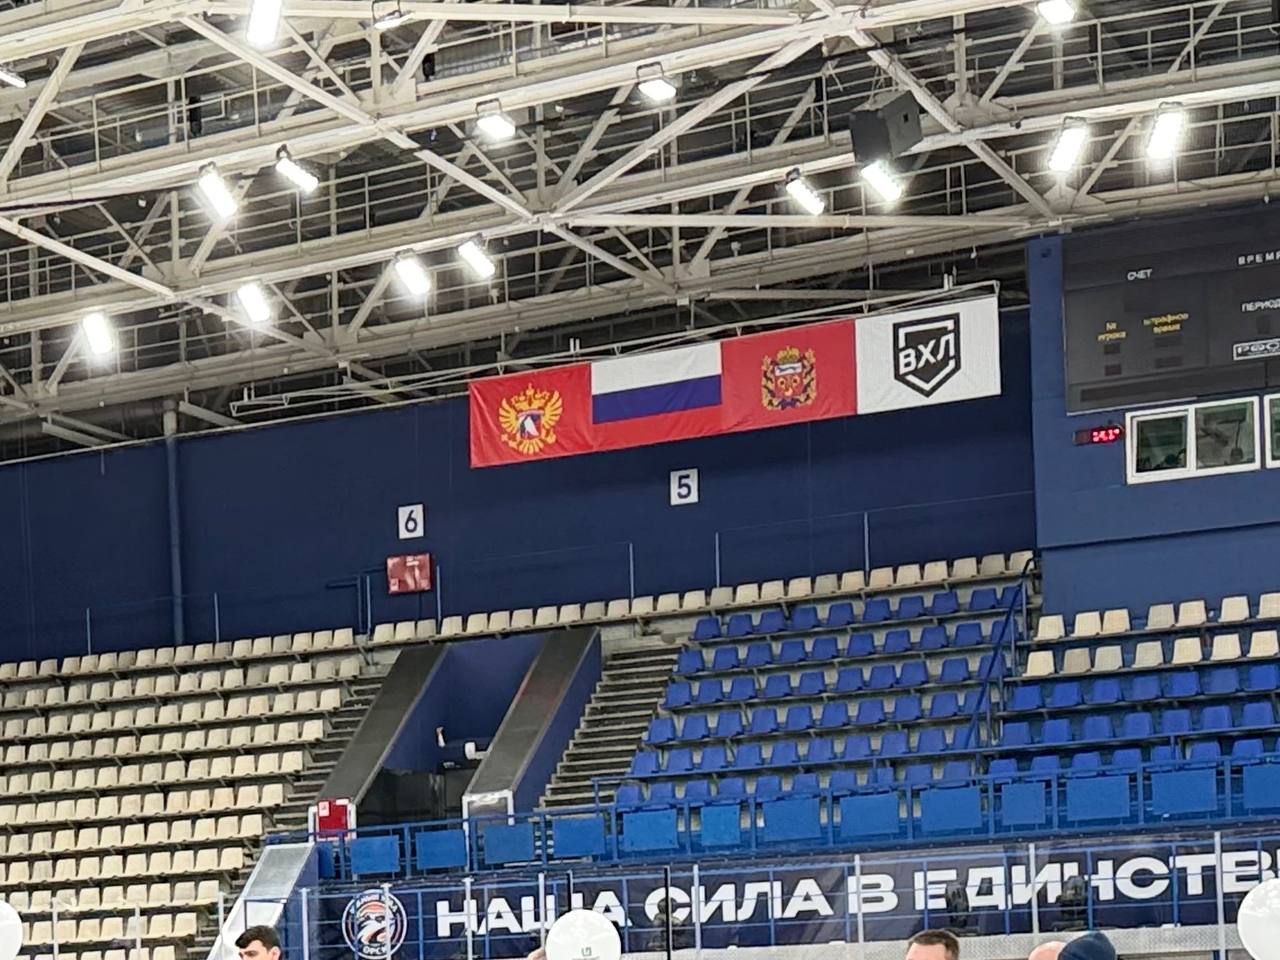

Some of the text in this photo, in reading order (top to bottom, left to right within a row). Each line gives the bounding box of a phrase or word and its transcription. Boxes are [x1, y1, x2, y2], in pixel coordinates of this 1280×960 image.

[899, 334, 955, 375] ВХЛ
[677, 475, 691, 499] 5
[405, 509, 418, 533] 6
[644, 878, 834, 924] СИЛА
[848, 874, 898, 914] В
[914, 849, 1280, 912] ЕДИНСТВ
